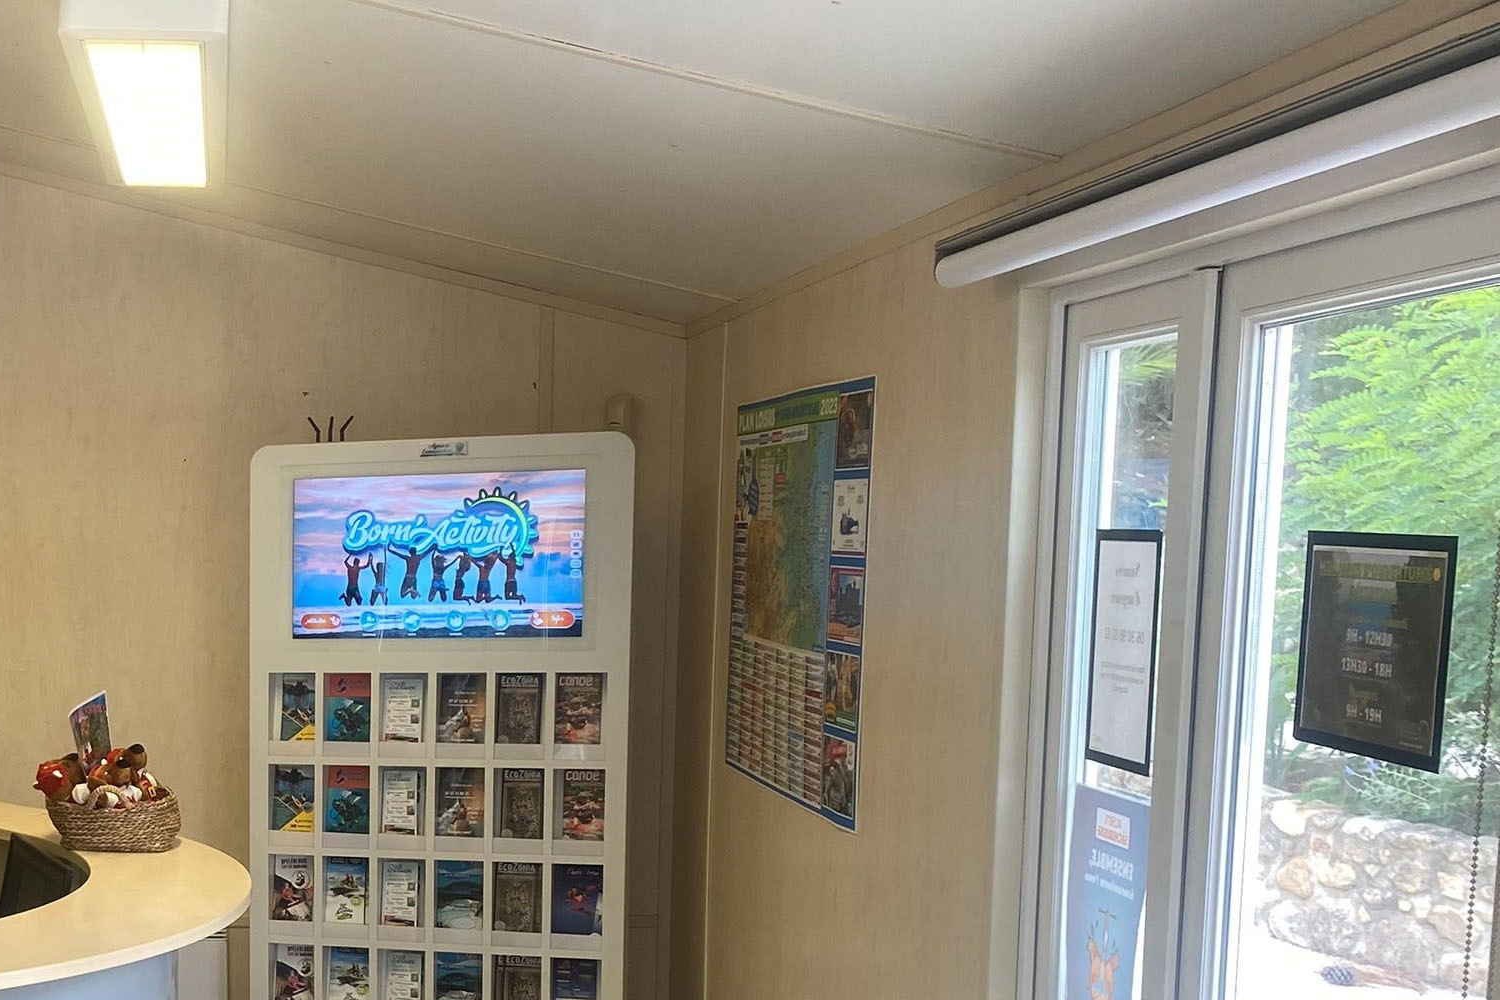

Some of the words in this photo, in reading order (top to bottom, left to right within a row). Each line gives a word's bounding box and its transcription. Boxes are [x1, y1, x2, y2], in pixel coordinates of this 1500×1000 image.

[820, 396, 838, 416] 2023
[1341, 657, 1368, 674] 13H30
[1374, 662, 1393, 678] 18H
[1364, 707, 1383, 724] 19H
